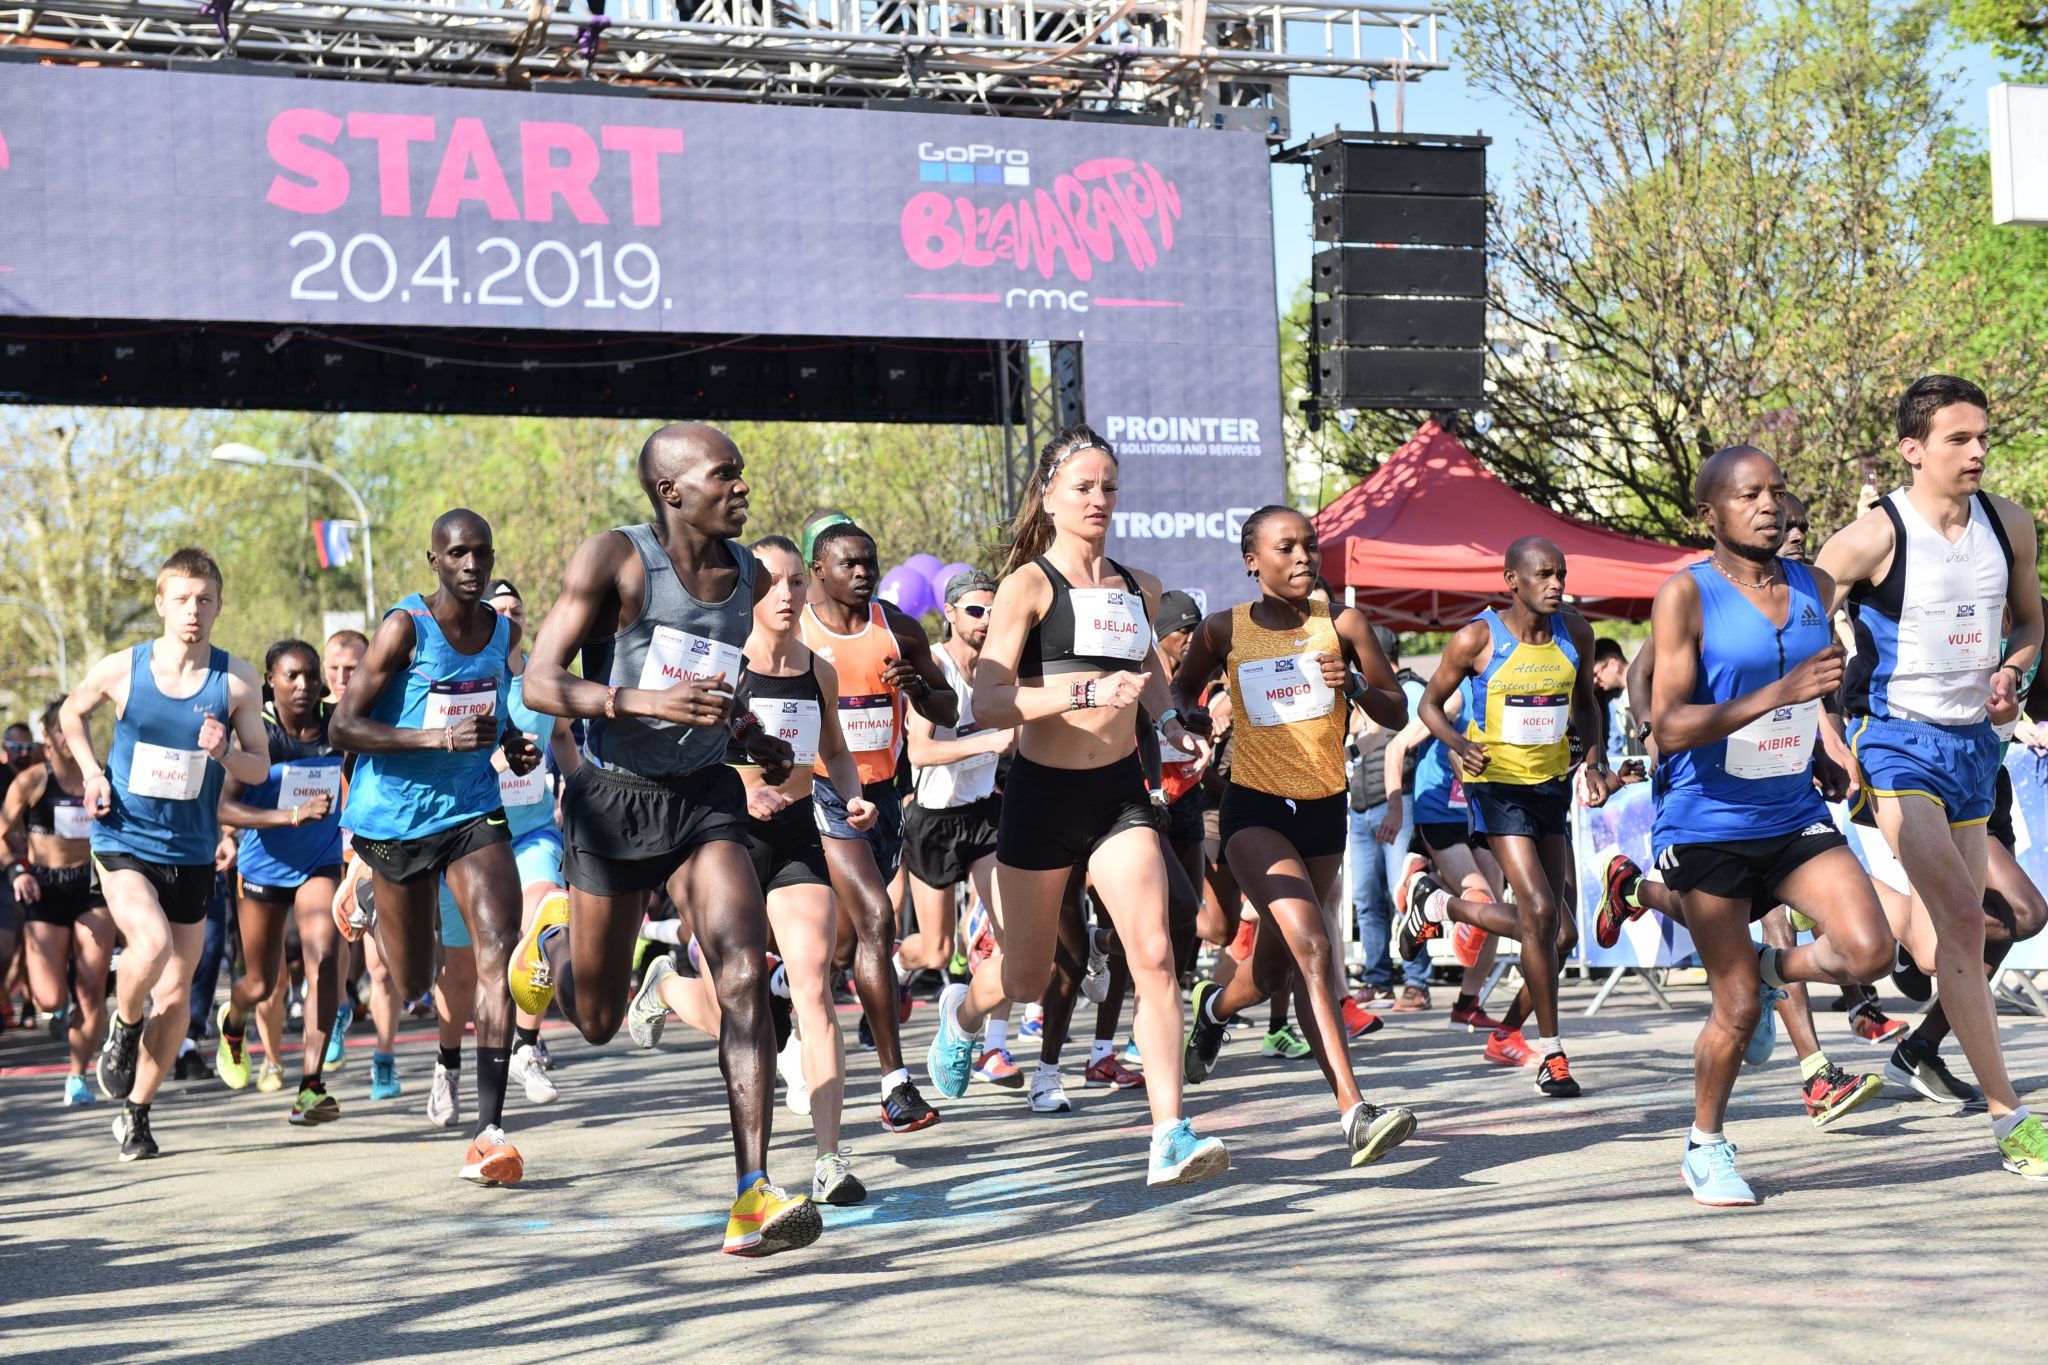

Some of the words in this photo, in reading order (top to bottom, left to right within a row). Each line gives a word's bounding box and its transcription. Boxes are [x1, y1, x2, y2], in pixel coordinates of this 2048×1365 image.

[918, 142, 1029, 165] GoPro
[266, 108, 684, 226] START
[288, 231, 672, 310] 20.4.2019.
[1006, 288, 1089, 312] rmc
[1106, 416, 1260, 442] PROINTER
[1120, 442, 1182, 455] SOLUTIONS
[1183, 444, 1208, 456] AND
[1209, 444, 1262, 456] SERVICES
[1112, 511, 1226, 539] TROPIC
[1957, 604, 1976, 613] 10K
[1094, 619, 1138, 634] BJELJAC
[1948, 629, 1982, 645] VUJIĆ
[693, 639, 712, 651] 10K
[1274, 658, 1294, 668] 10K
[1512, 663, 1561, 674] Atletica
[1266, 683, 1311, 700] MBOGO
[1490, 680, 1538, 692] Potenza
[440, 704, 468, 716] KIBET
[783, 702, 799, 710] 10K
[1774, 707, 1794, 717] 10K
[1523, 718, 1554, 726] KOECH
[780, 728, 799, 738] PAP
[1758, 735, 1801, 752] KIBIRE
